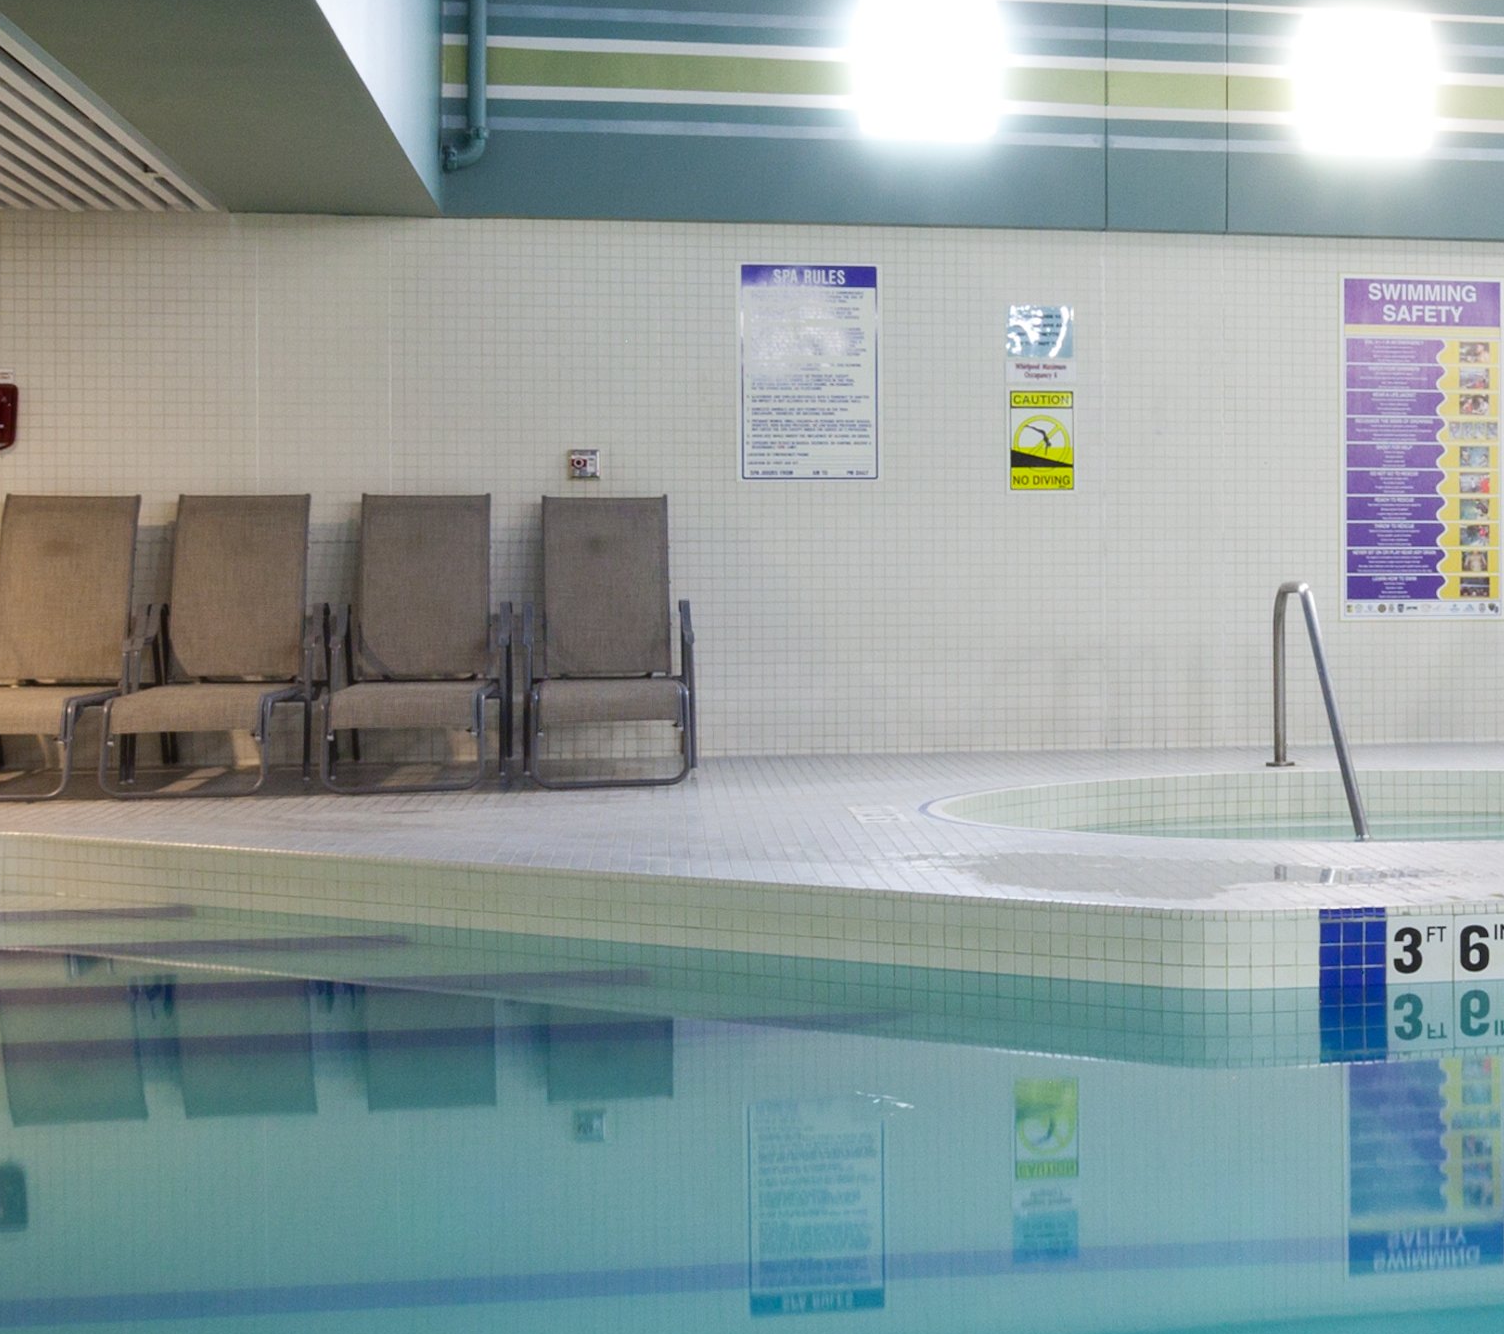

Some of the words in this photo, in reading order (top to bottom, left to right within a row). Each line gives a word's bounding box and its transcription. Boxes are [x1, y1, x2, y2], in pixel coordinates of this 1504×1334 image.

[773, 269, 798, 284] SPA
[804, 269, 846, 285] RULES
[1368, 282, 1477, 303] SWIMMING
[1382, 304, 1464, 323] SAFETY
[1013, 394, 1070, 405] CAUTION
[1012, 475, 1029, 485] NO
[1033, 475, 1071, 485] DIVING
[1393, 927, 1423, 974] 3
[1426, 926, 1447, 942] FT
[1459, 924, 1490, 972] 6
